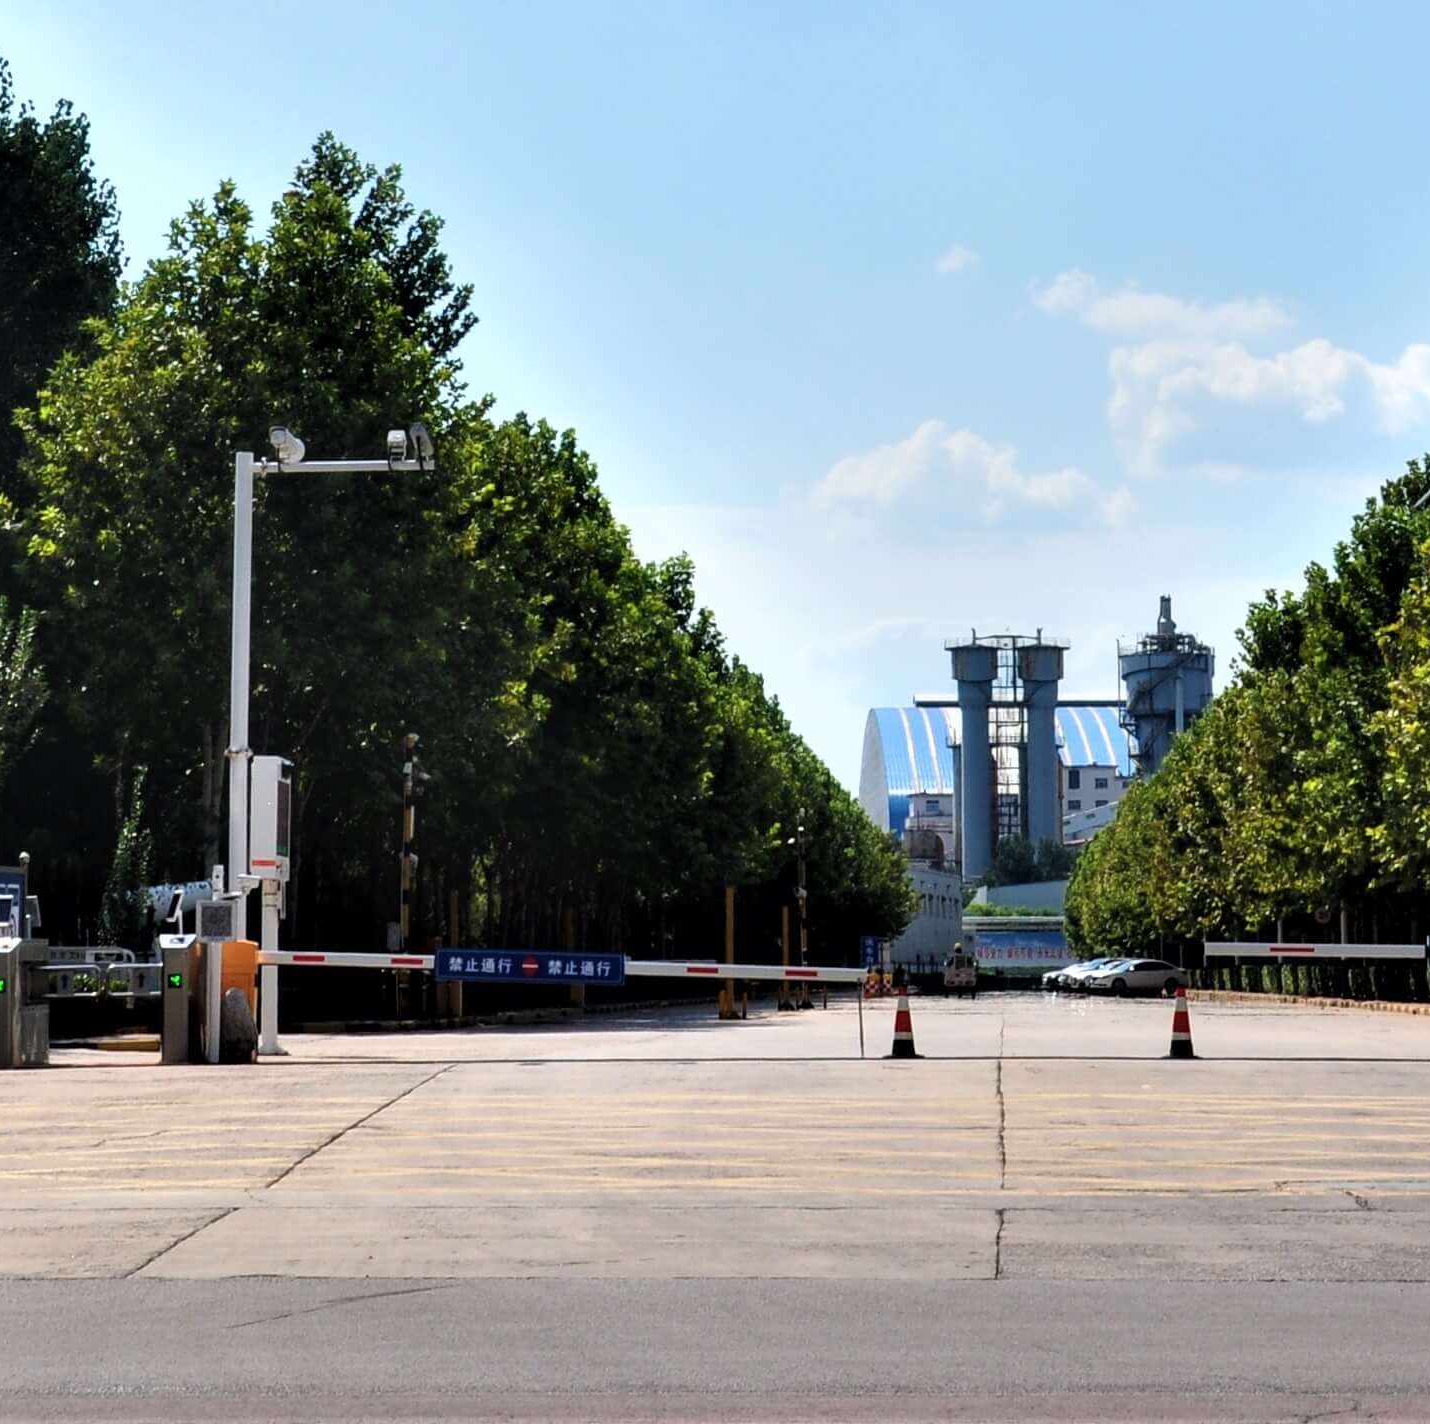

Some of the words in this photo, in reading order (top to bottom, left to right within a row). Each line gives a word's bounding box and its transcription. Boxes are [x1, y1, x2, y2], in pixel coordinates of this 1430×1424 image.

[448, 956, 514, 974] 禁止通行
[547, 959, 612, 977] 禁止通行
